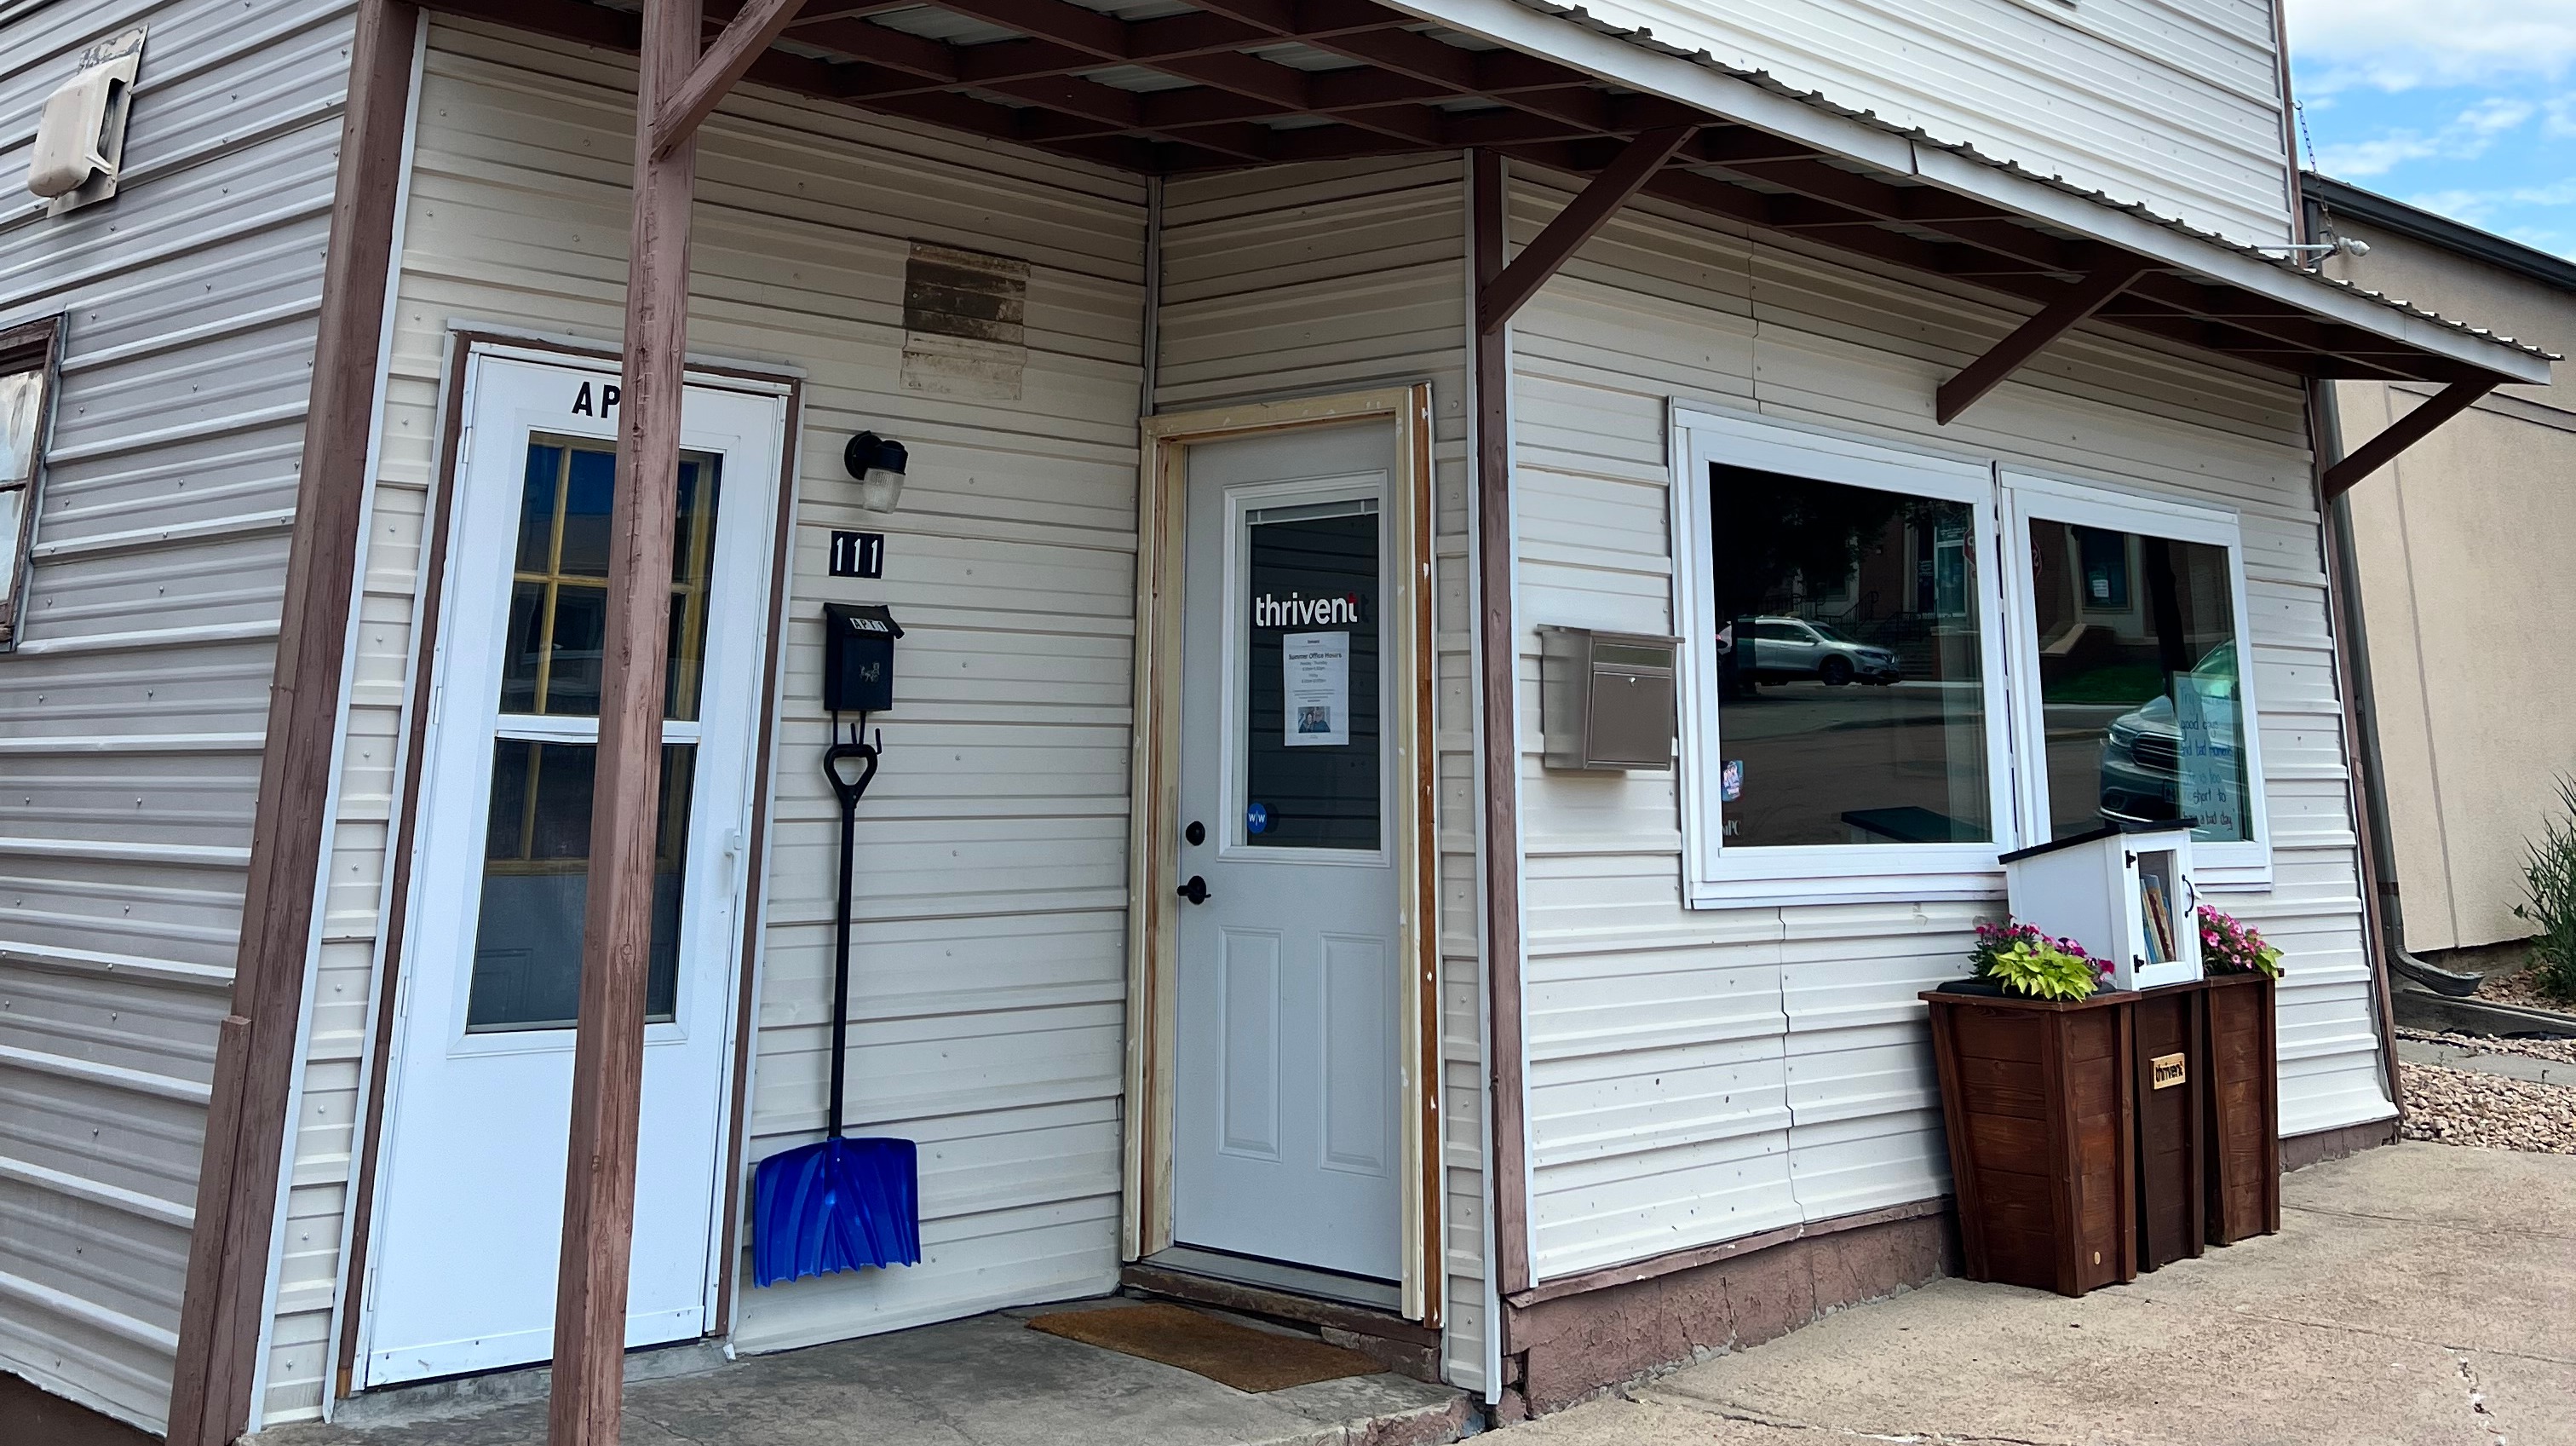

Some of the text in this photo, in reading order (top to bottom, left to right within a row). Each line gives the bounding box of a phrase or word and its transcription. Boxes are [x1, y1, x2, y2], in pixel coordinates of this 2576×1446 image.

[571, 381, 621, 418] AP
[837, 537, 878, 573] 111
[1256, 591, 1359, 627] thrivent
[2181, 713, 2199, 742] good
[2195, 740, 2207, 757] bad
[2193, 787, 2212, 805] short
[2217, 787, 2227, 803] to
[2205, 810, 2217, 825] bad
